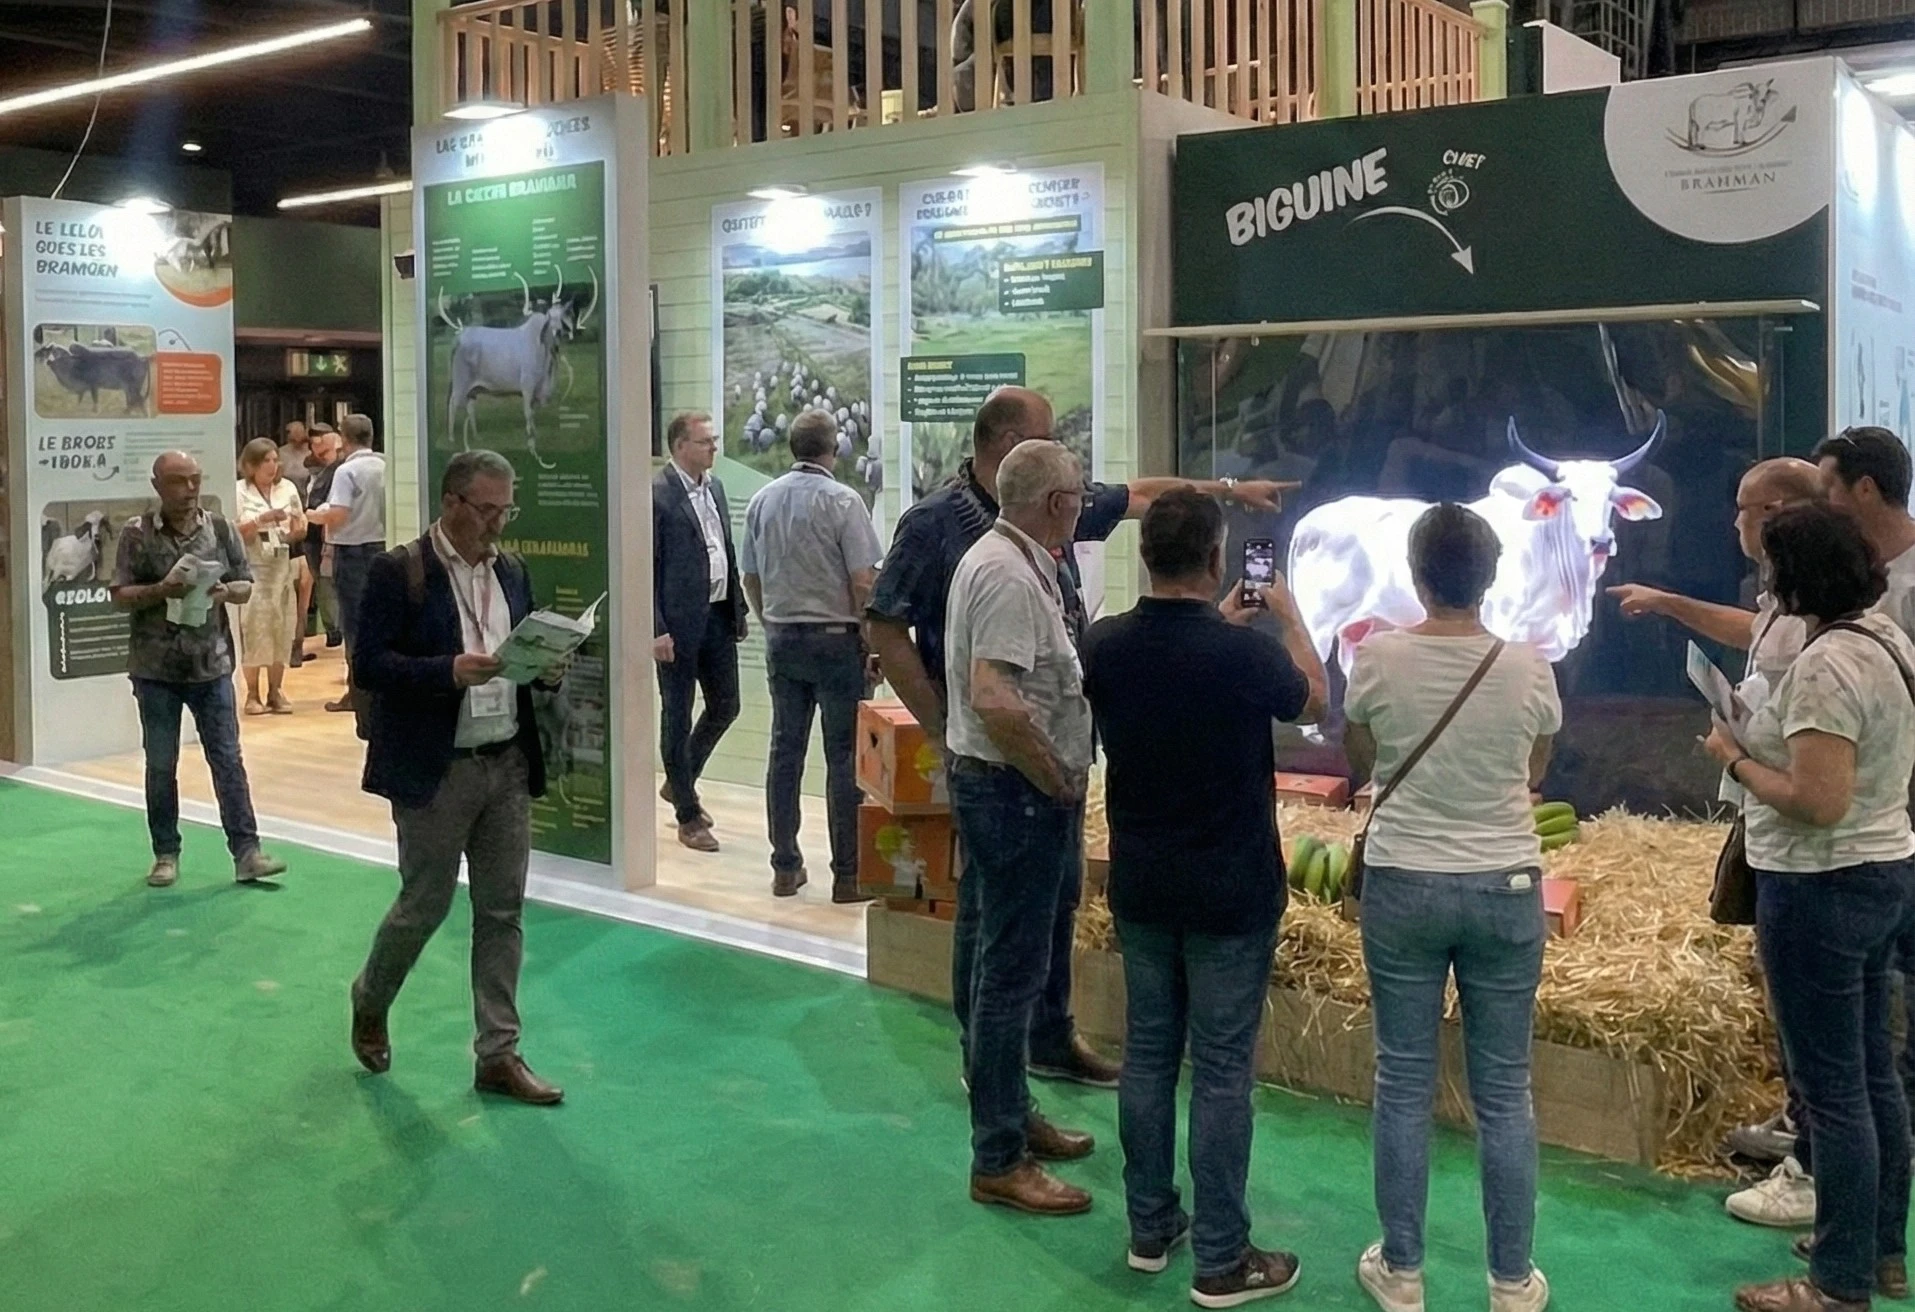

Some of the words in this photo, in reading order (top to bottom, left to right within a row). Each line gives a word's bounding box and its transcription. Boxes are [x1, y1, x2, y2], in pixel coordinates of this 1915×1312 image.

[1681, 172, 1776, 190] BRAHMAN
[1226, 147, 1388, 246] BIGUINE
[36, 221, 54, 235] LE
[39, 436, 57, 451] LE
